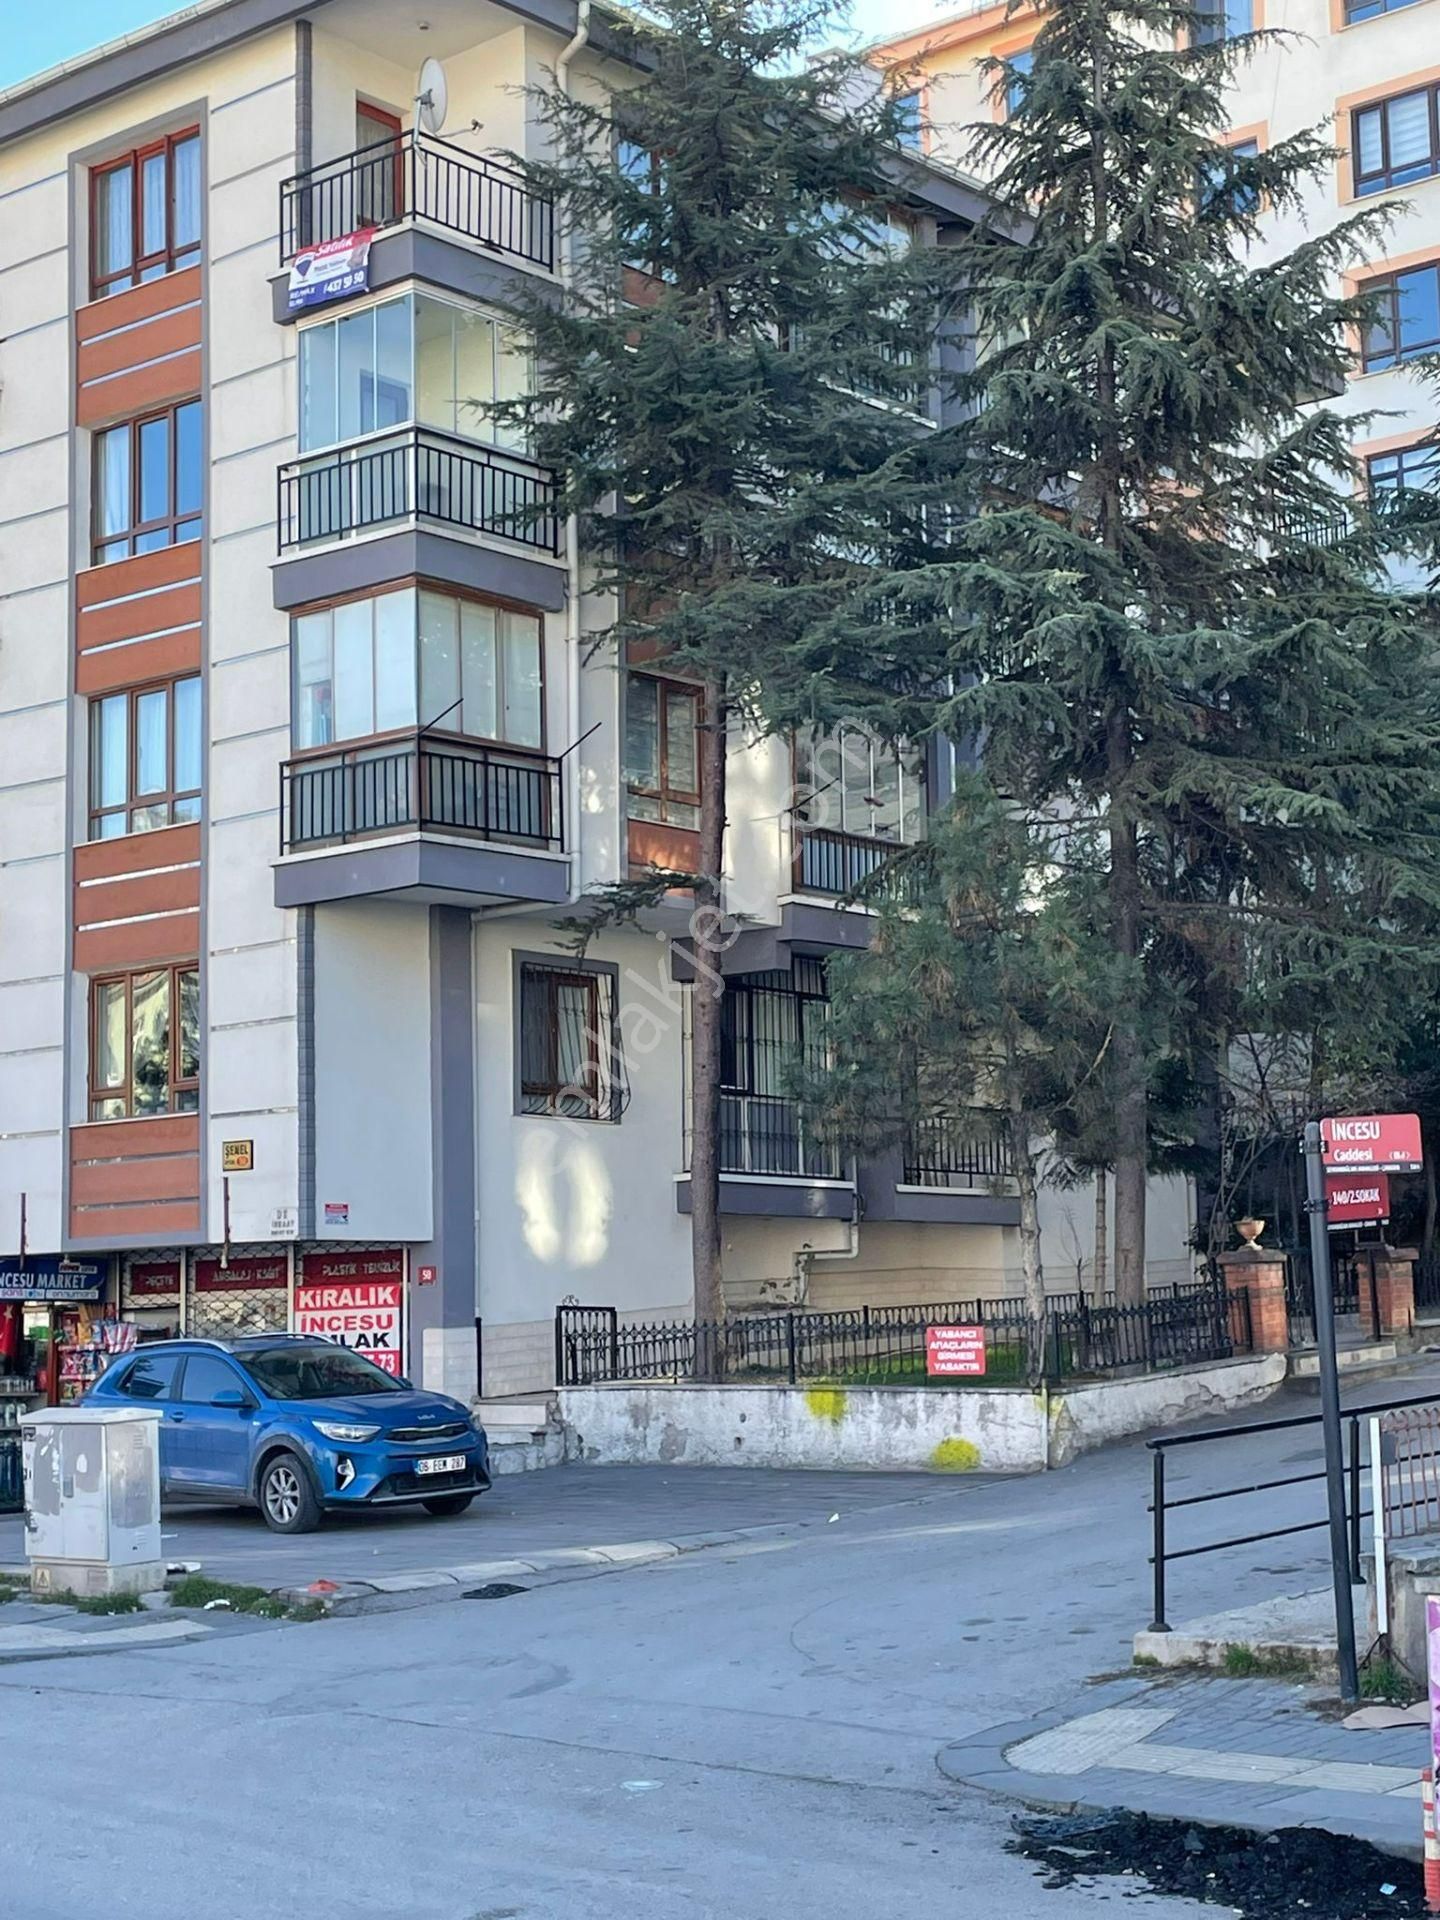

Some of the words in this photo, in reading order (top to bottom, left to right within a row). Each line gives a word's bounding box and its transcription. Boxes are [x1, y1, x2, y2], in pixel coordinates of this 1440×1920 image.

[1331, 1119, 1380, 1141] İNCESU
[1333, 1148, 1373, 1161] Caddesi
[0, 1272, 34, 1288] NCESU
[36, 1273, 87, 1289] MARKET
[301, 1314, 393, 1333] İNCESU
